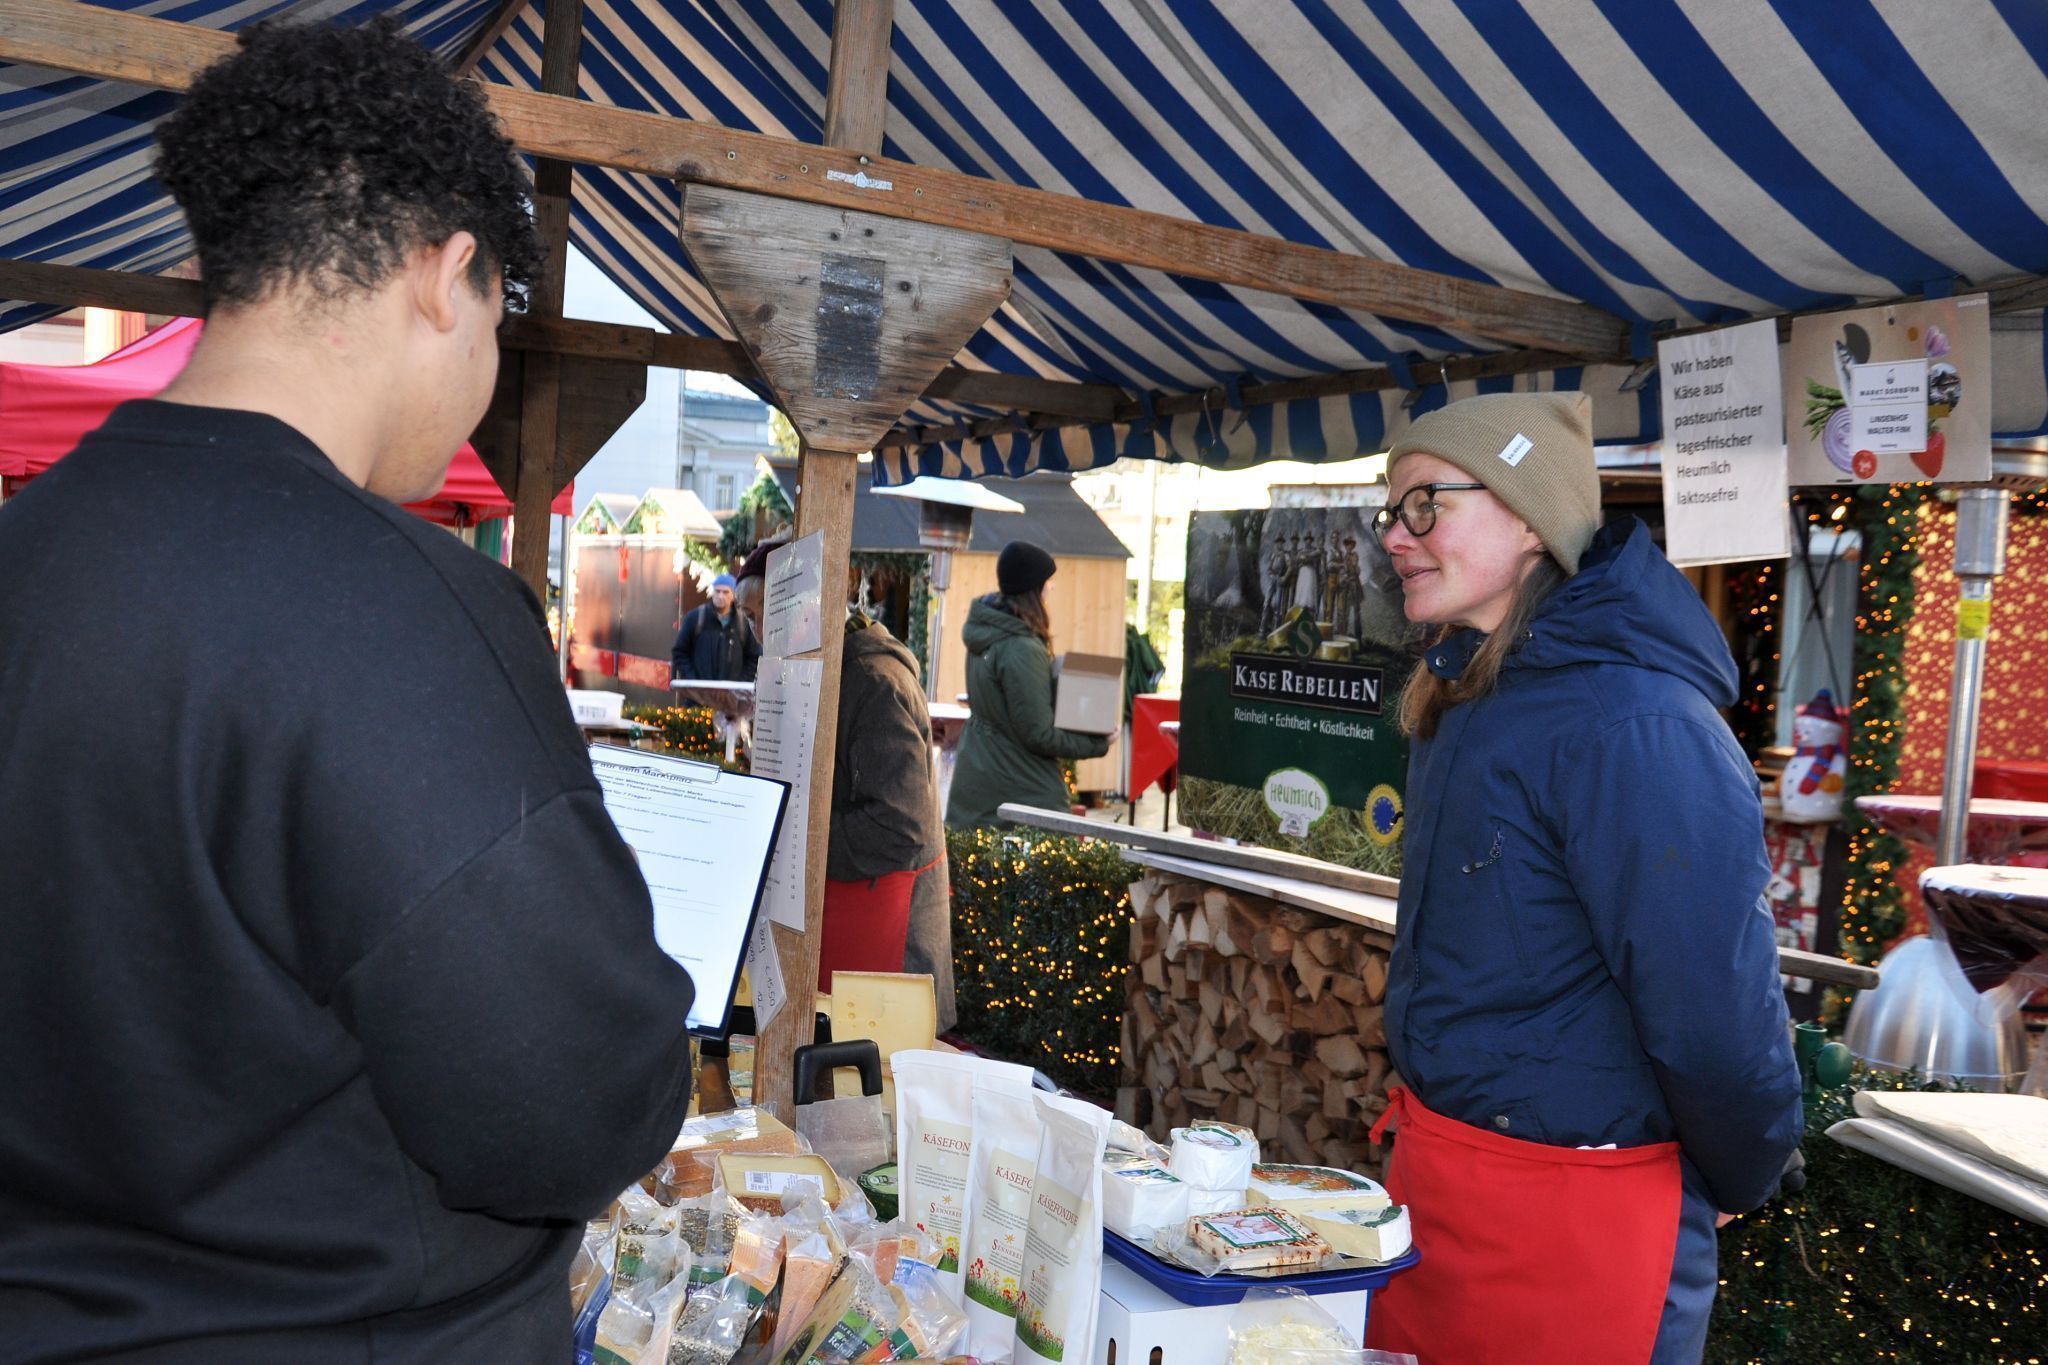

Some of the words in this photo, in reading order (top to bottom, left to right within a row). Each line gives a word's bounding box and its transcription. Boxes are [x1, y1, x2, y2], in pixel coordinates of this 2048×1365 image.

[1670, 360, 1693, 376] Wir
[1695, 355, 1733, 371] haben
[1673, 385, 1701, 400] Käse
[1703, 382, 1724, 396] aus
[1859, 388, 1884, 397] MARKT
[1674, 404, 1763, 431] pasteurisierter
[1676, 433, 1753, 456] tagesfrischer
[1676, 460, 1731, 478] Heumilch
[1676, 486, 1739, 505] laktosefrei
[1234, 664, 1277, 691] KÄSE
[1280, 669, 1379, 703] REBELLEN
[1234, 707, 1267, 725] Reinheit
[1275, 713, 1311, 731] Echtheit
[1319, 719, 1375, 741] Köstlichkeit
[1037, 1193, 1079, 1227] KÄSEFONDUE
